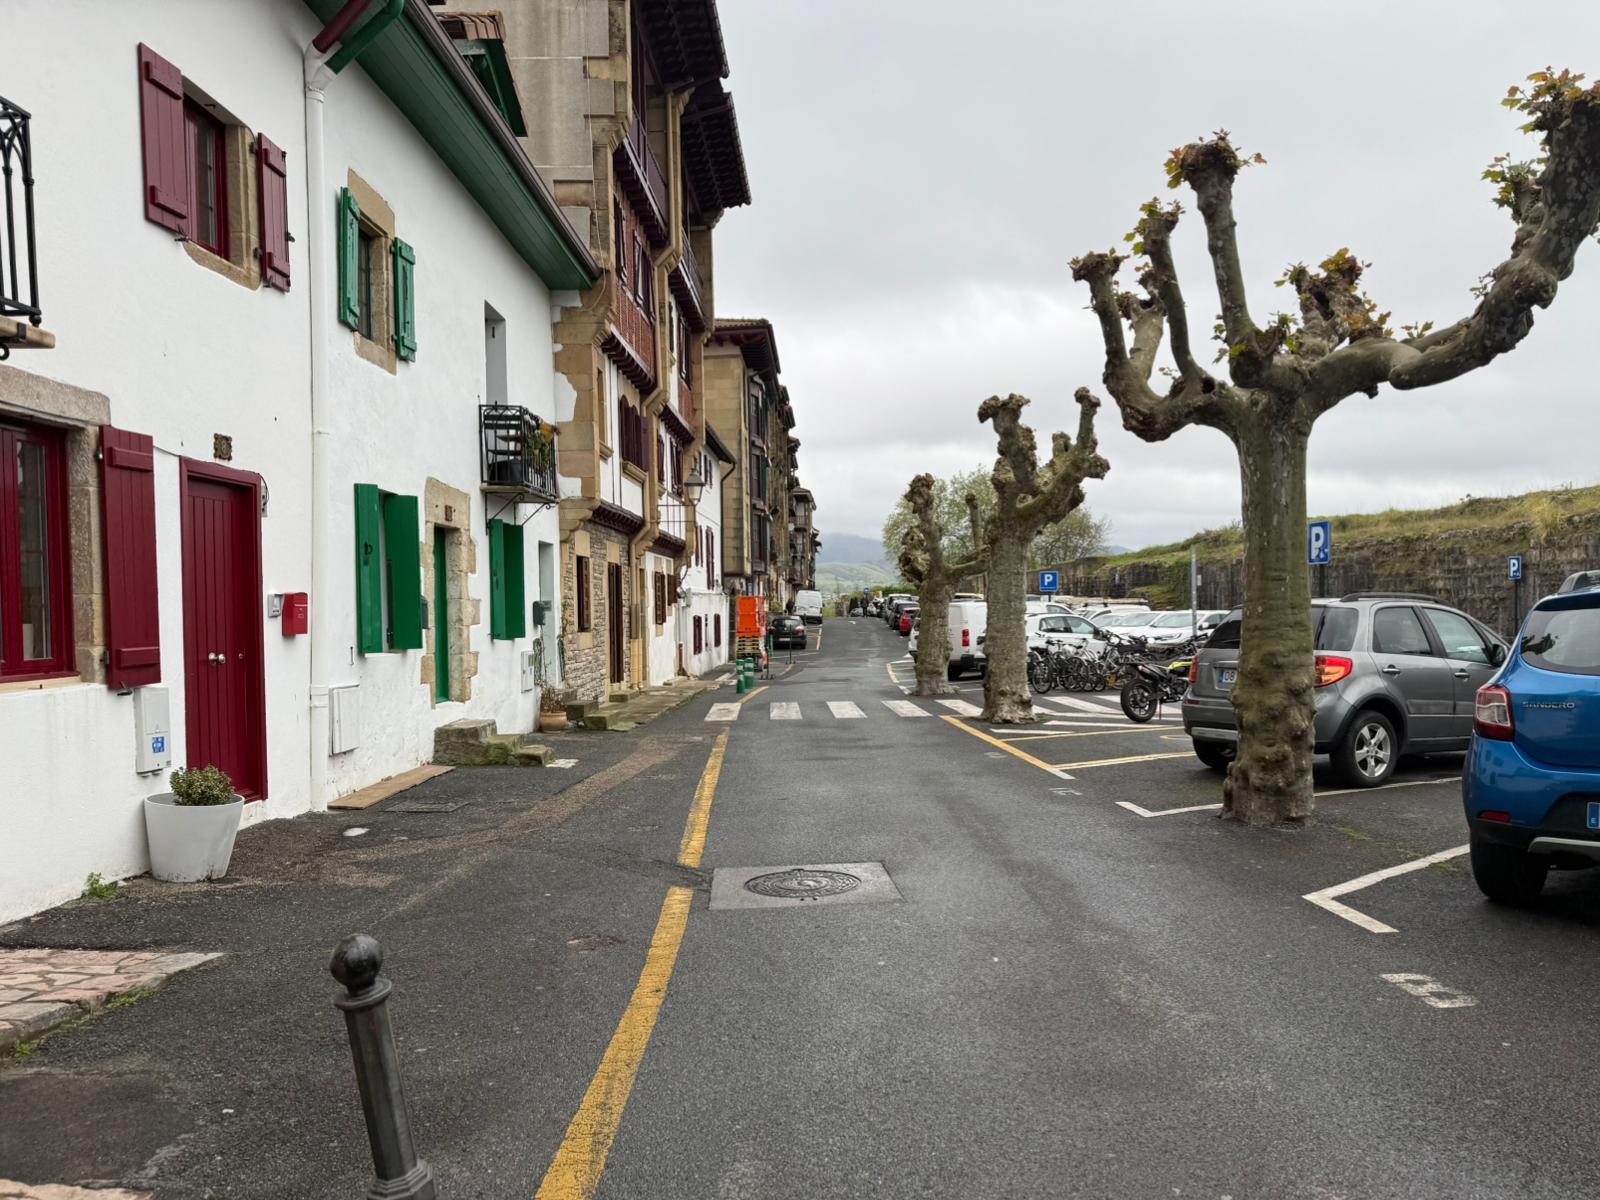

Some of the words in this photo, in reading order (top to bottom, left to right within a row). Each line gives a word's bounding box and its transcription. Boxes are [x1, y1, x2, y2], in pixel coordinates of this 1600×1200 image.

[1311, 526, 1325, 560] P
[1510, 559, 1518, 576] P
[1044, 574, 1053, 586] P
